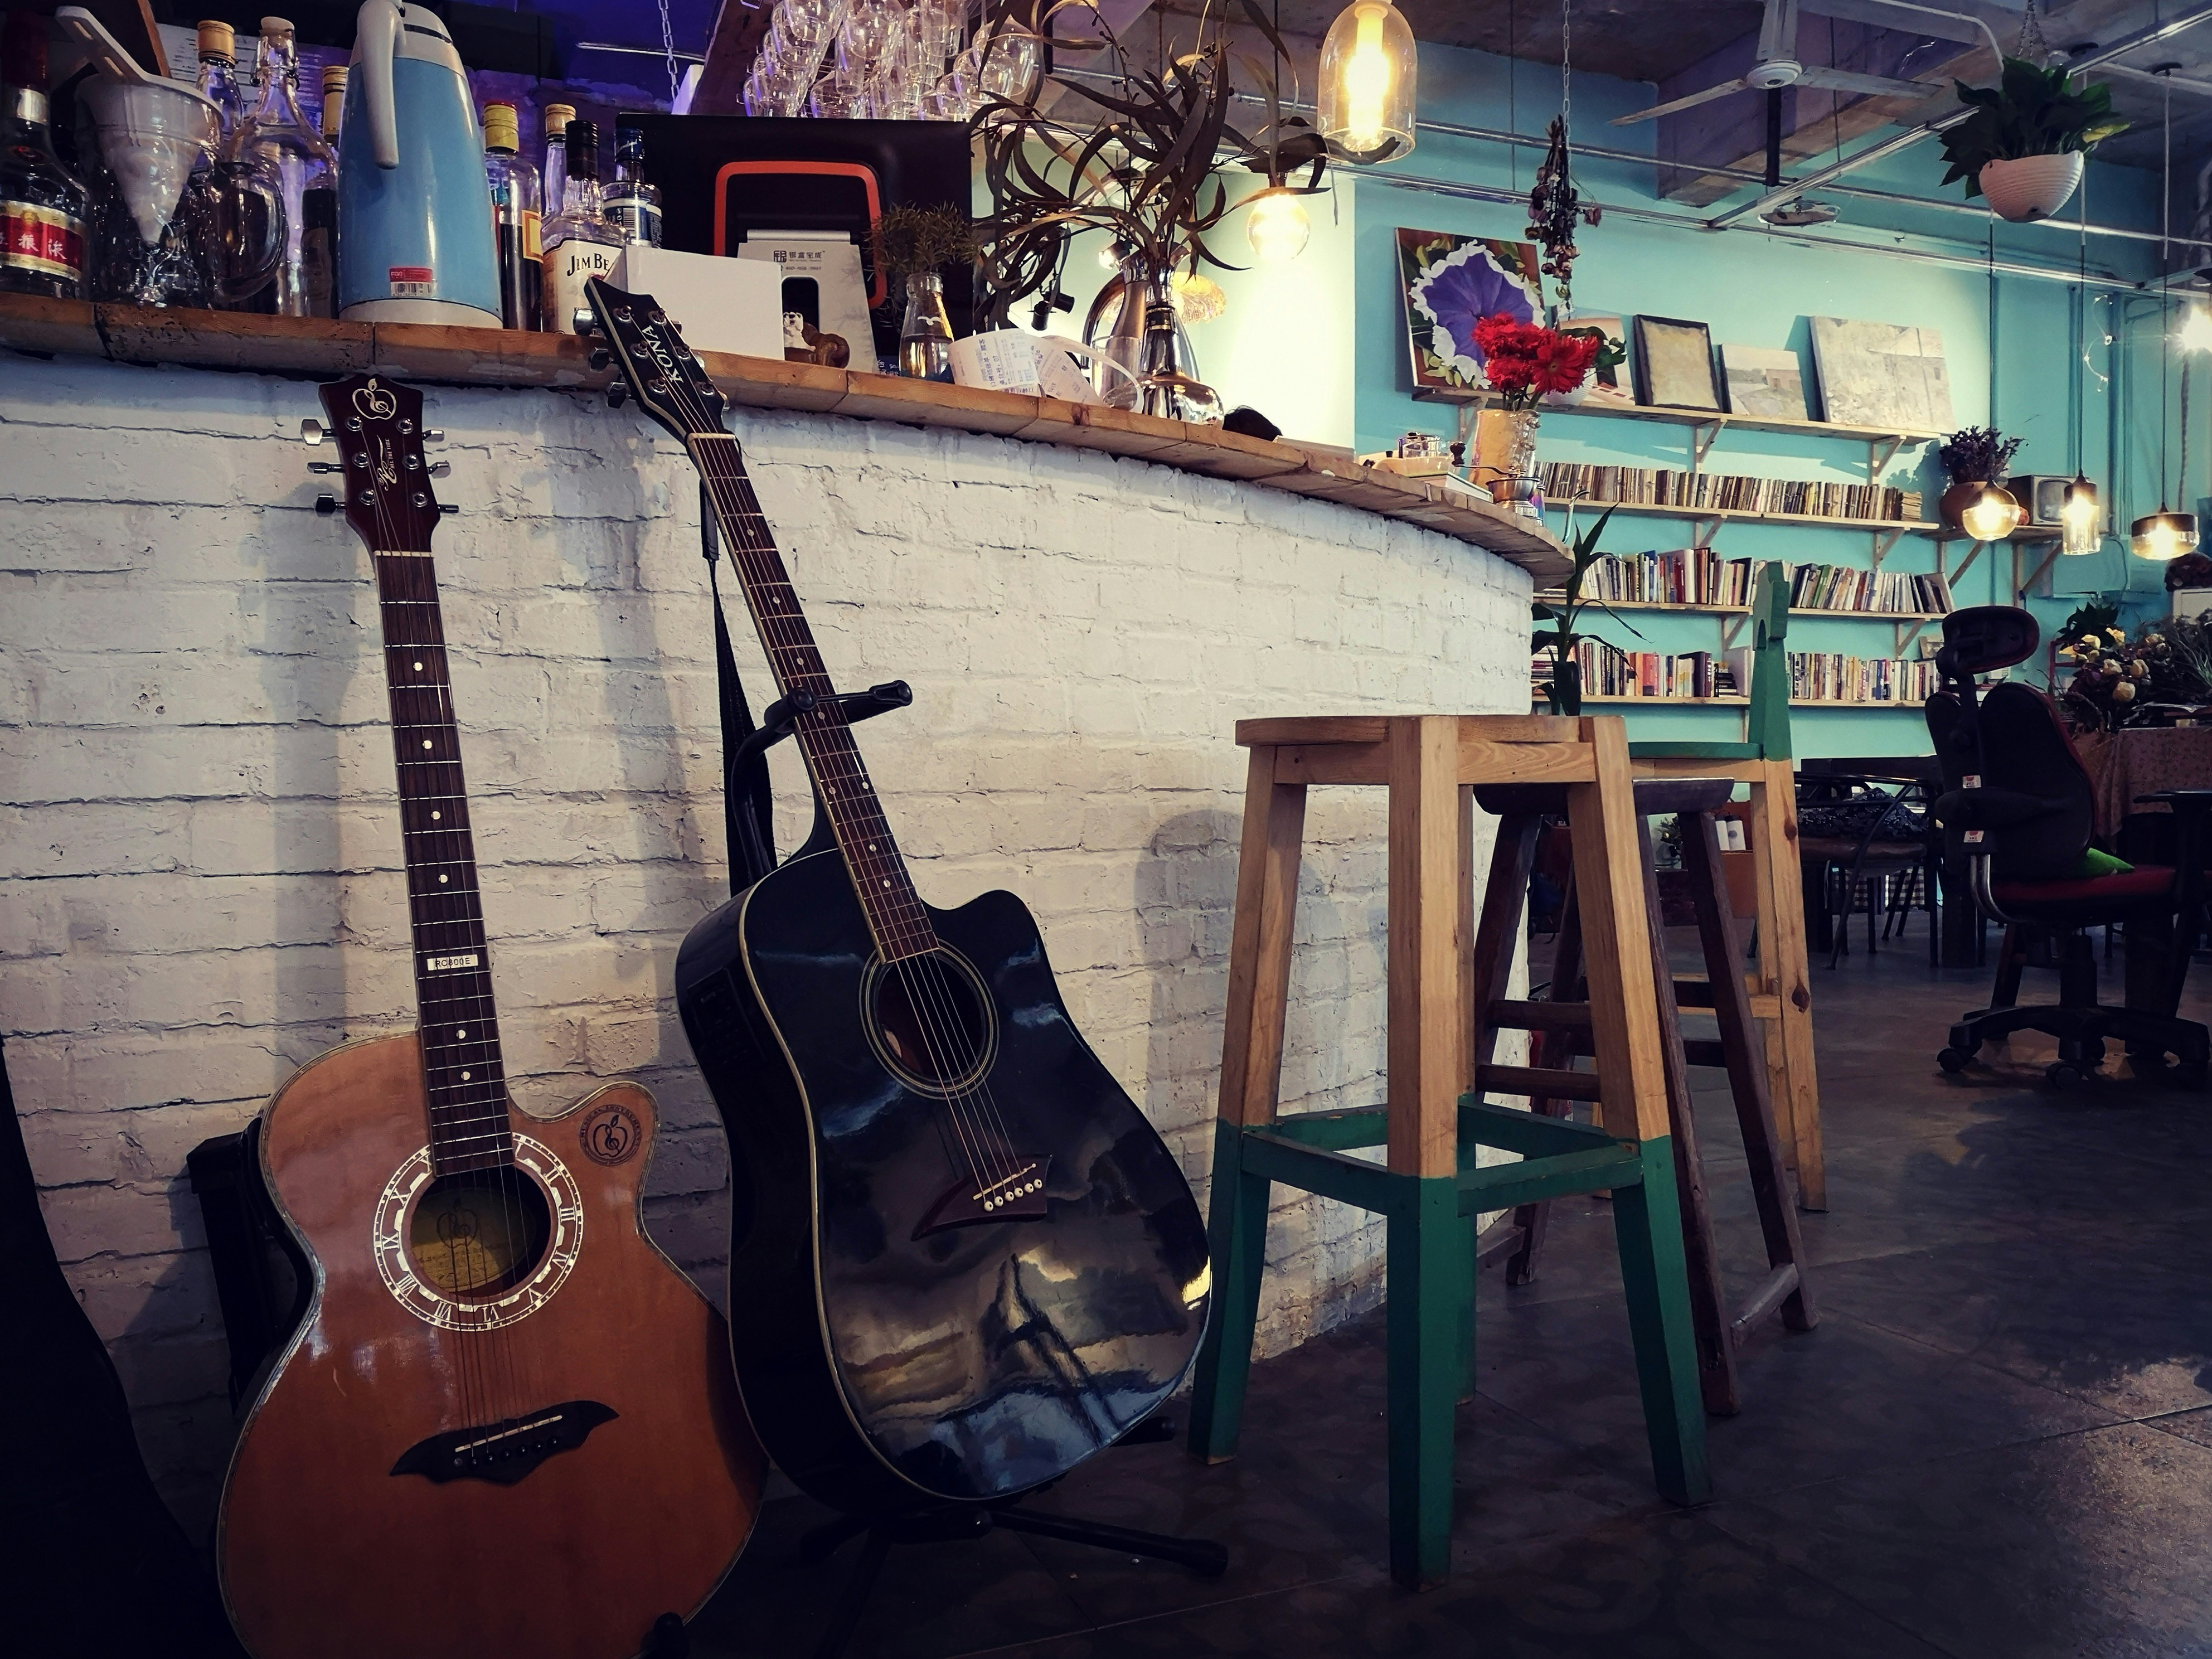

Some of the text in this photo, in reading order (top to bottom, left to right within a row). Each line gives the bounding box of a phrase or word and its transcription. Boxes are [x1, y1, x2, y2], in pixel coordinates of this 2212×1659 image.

[567, 253, 610, 276] JIM BE
[641, 325, 683, 384] KONA
[560, 1206, 575, 1223] III
